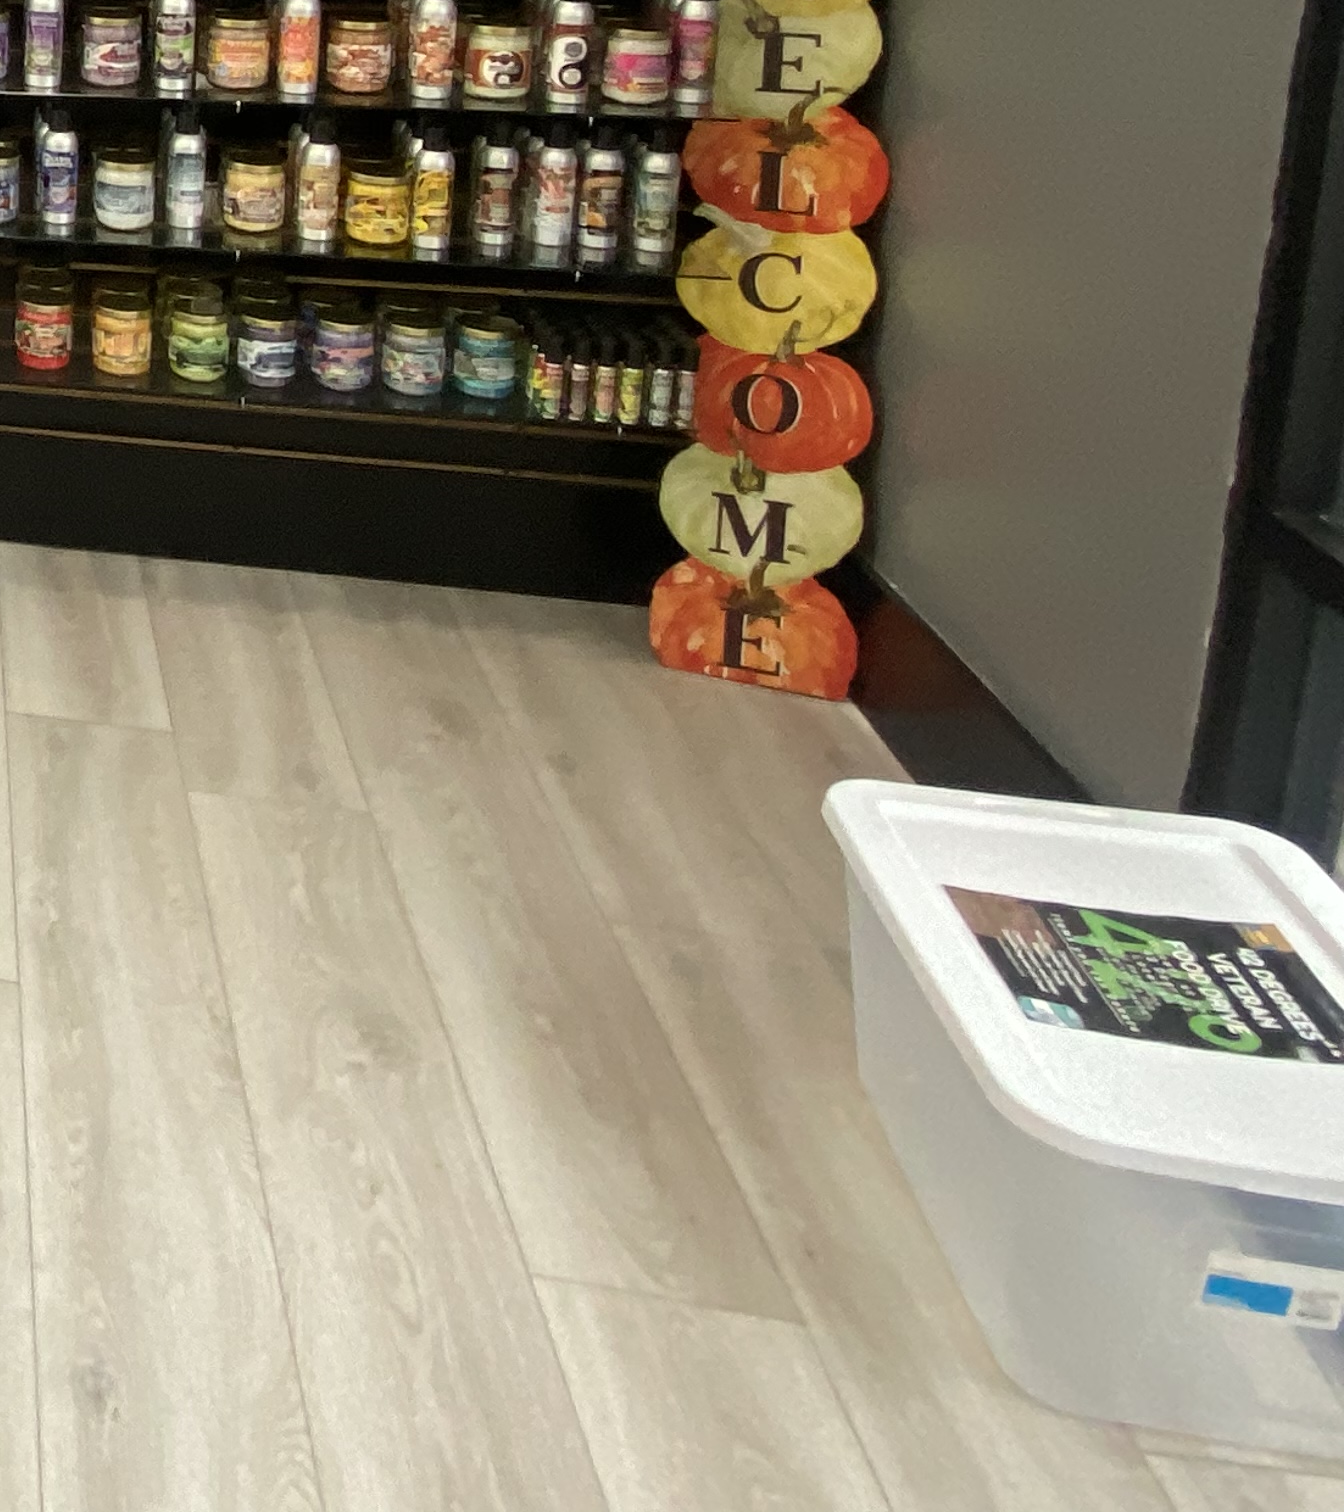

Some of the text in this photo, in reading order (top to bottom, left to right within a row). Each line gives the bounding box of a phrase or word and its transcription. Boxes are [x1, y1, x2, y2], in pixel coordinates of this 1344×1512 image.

[1162, 939, 1252, 1035] FOOD DRIVE
[1207, 952, 1283, 1030] VETERAN
[1248, 968, 1325, 1041] DEGREES
